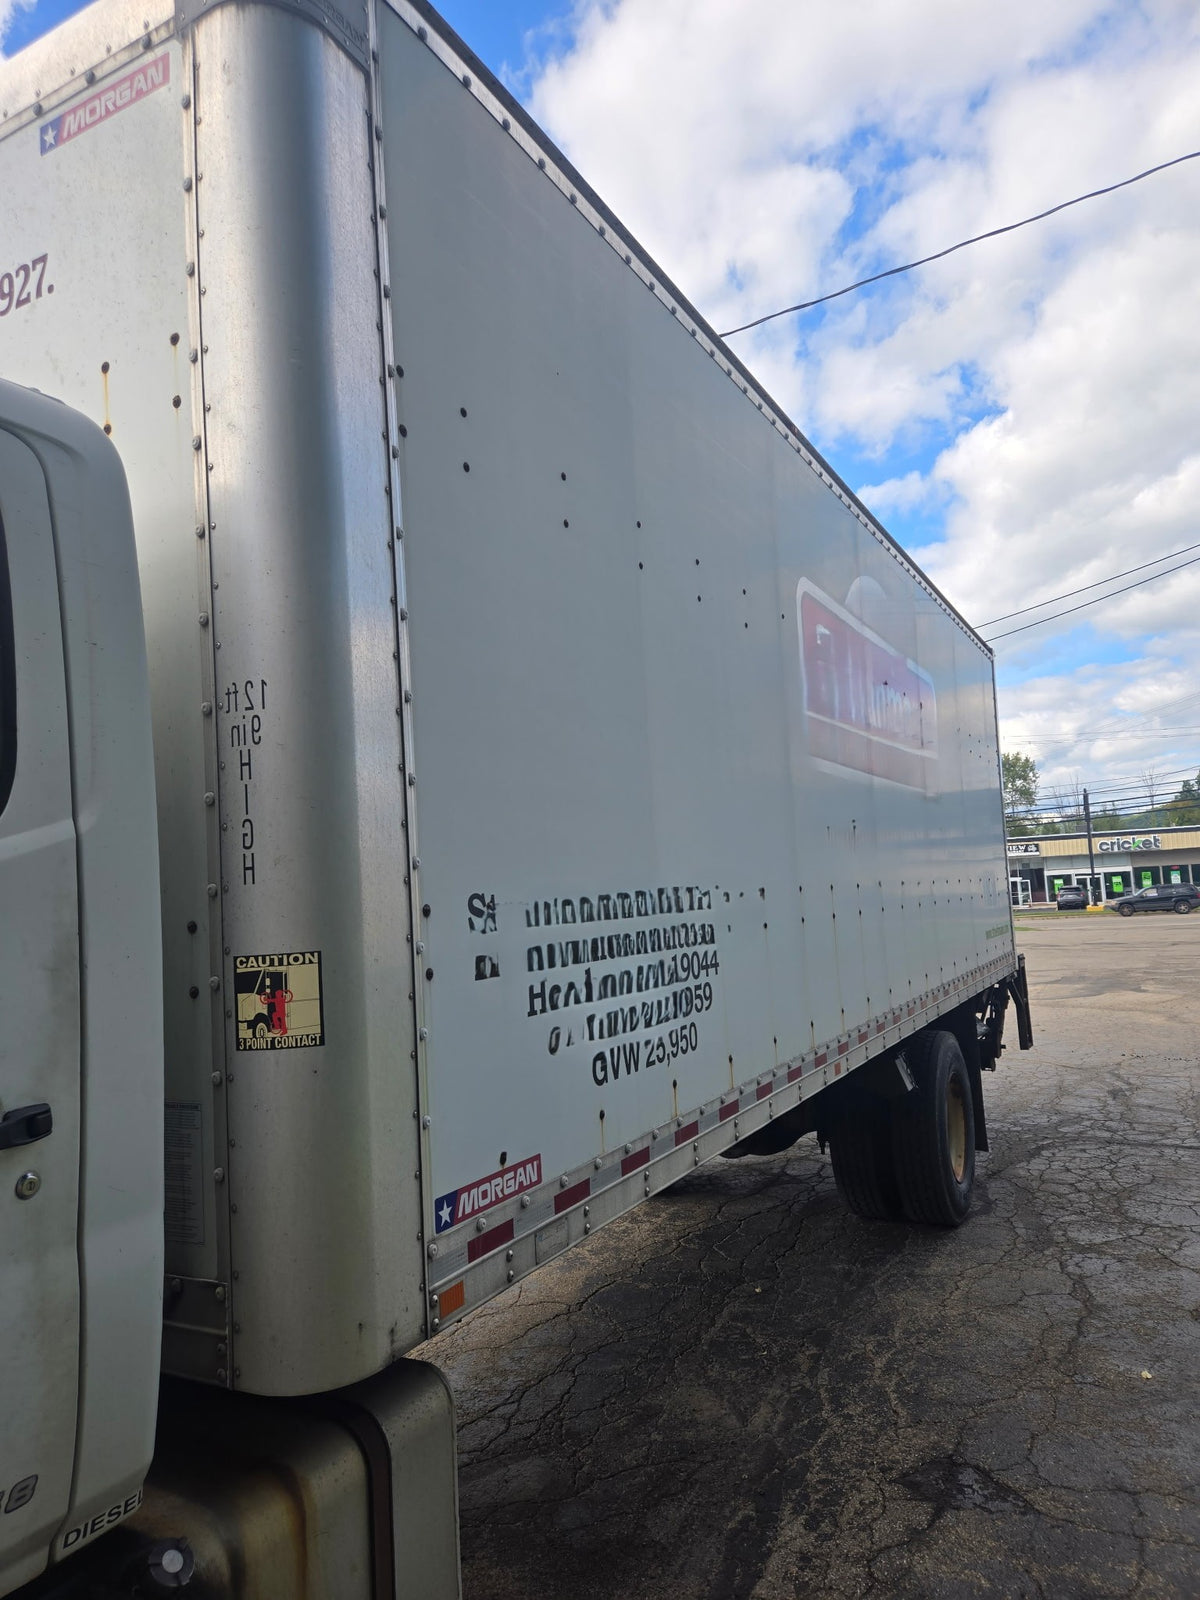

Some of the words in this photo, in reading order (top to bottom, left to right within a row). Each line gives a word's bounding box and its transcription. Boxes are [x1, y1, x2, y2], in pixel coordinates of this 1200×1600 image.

[62, 59, 164, 140] MORGAN
[1098, 834, 1161, 852] cricket
[236, 952, 319, 968] CAUTION
[671, 950, 720, 986] 19044
[239, 1039, 245, 1050] 3
[246, 1037, 273, 1050] POINT
[275, 1033, 321, 1049] CONTACT
[592, 1041, 640, 1087] GVW
[457, 1161, 538, 1218] MORGAN
